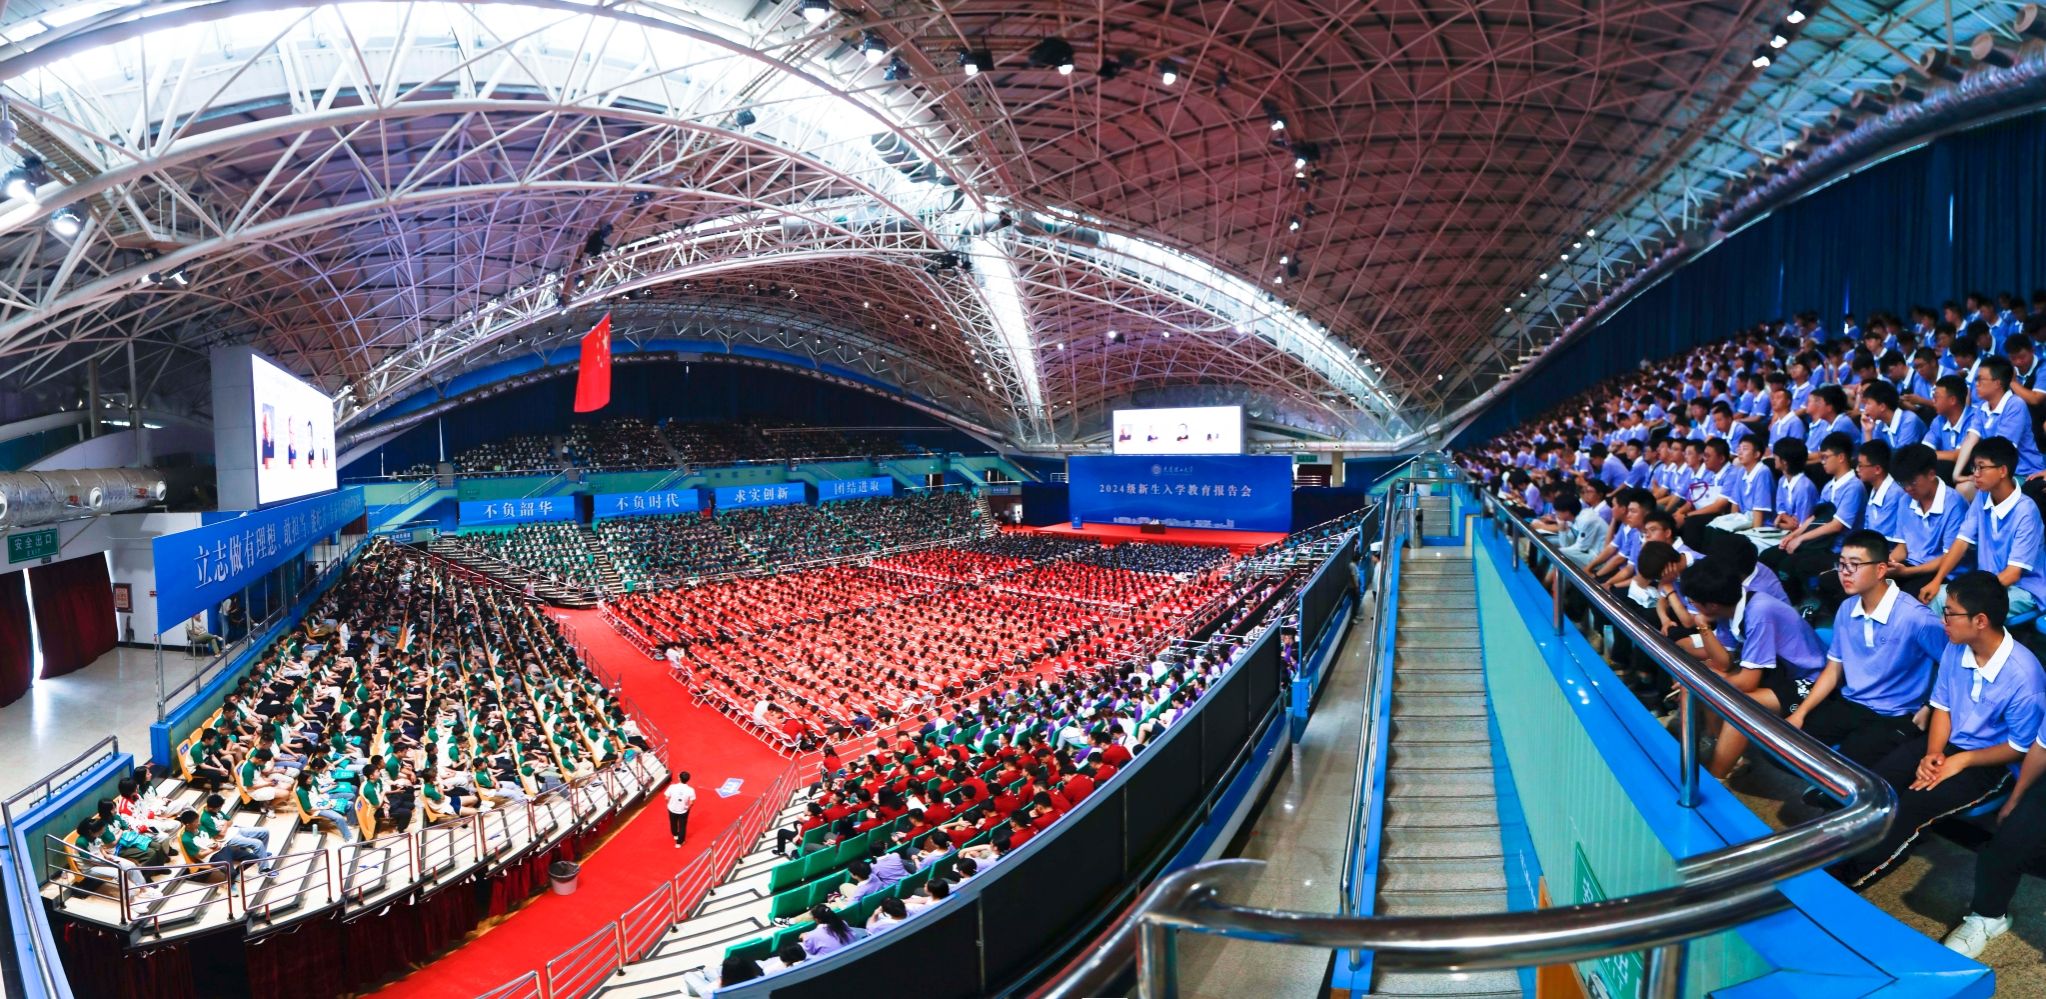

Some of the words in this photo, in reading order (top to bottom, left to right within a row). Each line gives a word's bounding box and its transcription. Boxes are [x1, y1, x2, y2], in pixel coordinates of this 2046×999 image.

[734, 486, 788, 503] 求实创新
[834, 480, 880, 495] 团结进取
[1100, 483, 1253, 497] 2024级新生入学教育报告会
[483, 501, 553, 519] 不负韶华
[616, 493, 679, 511] 不负时代
[14, 533, 52, 551] 安全出口
